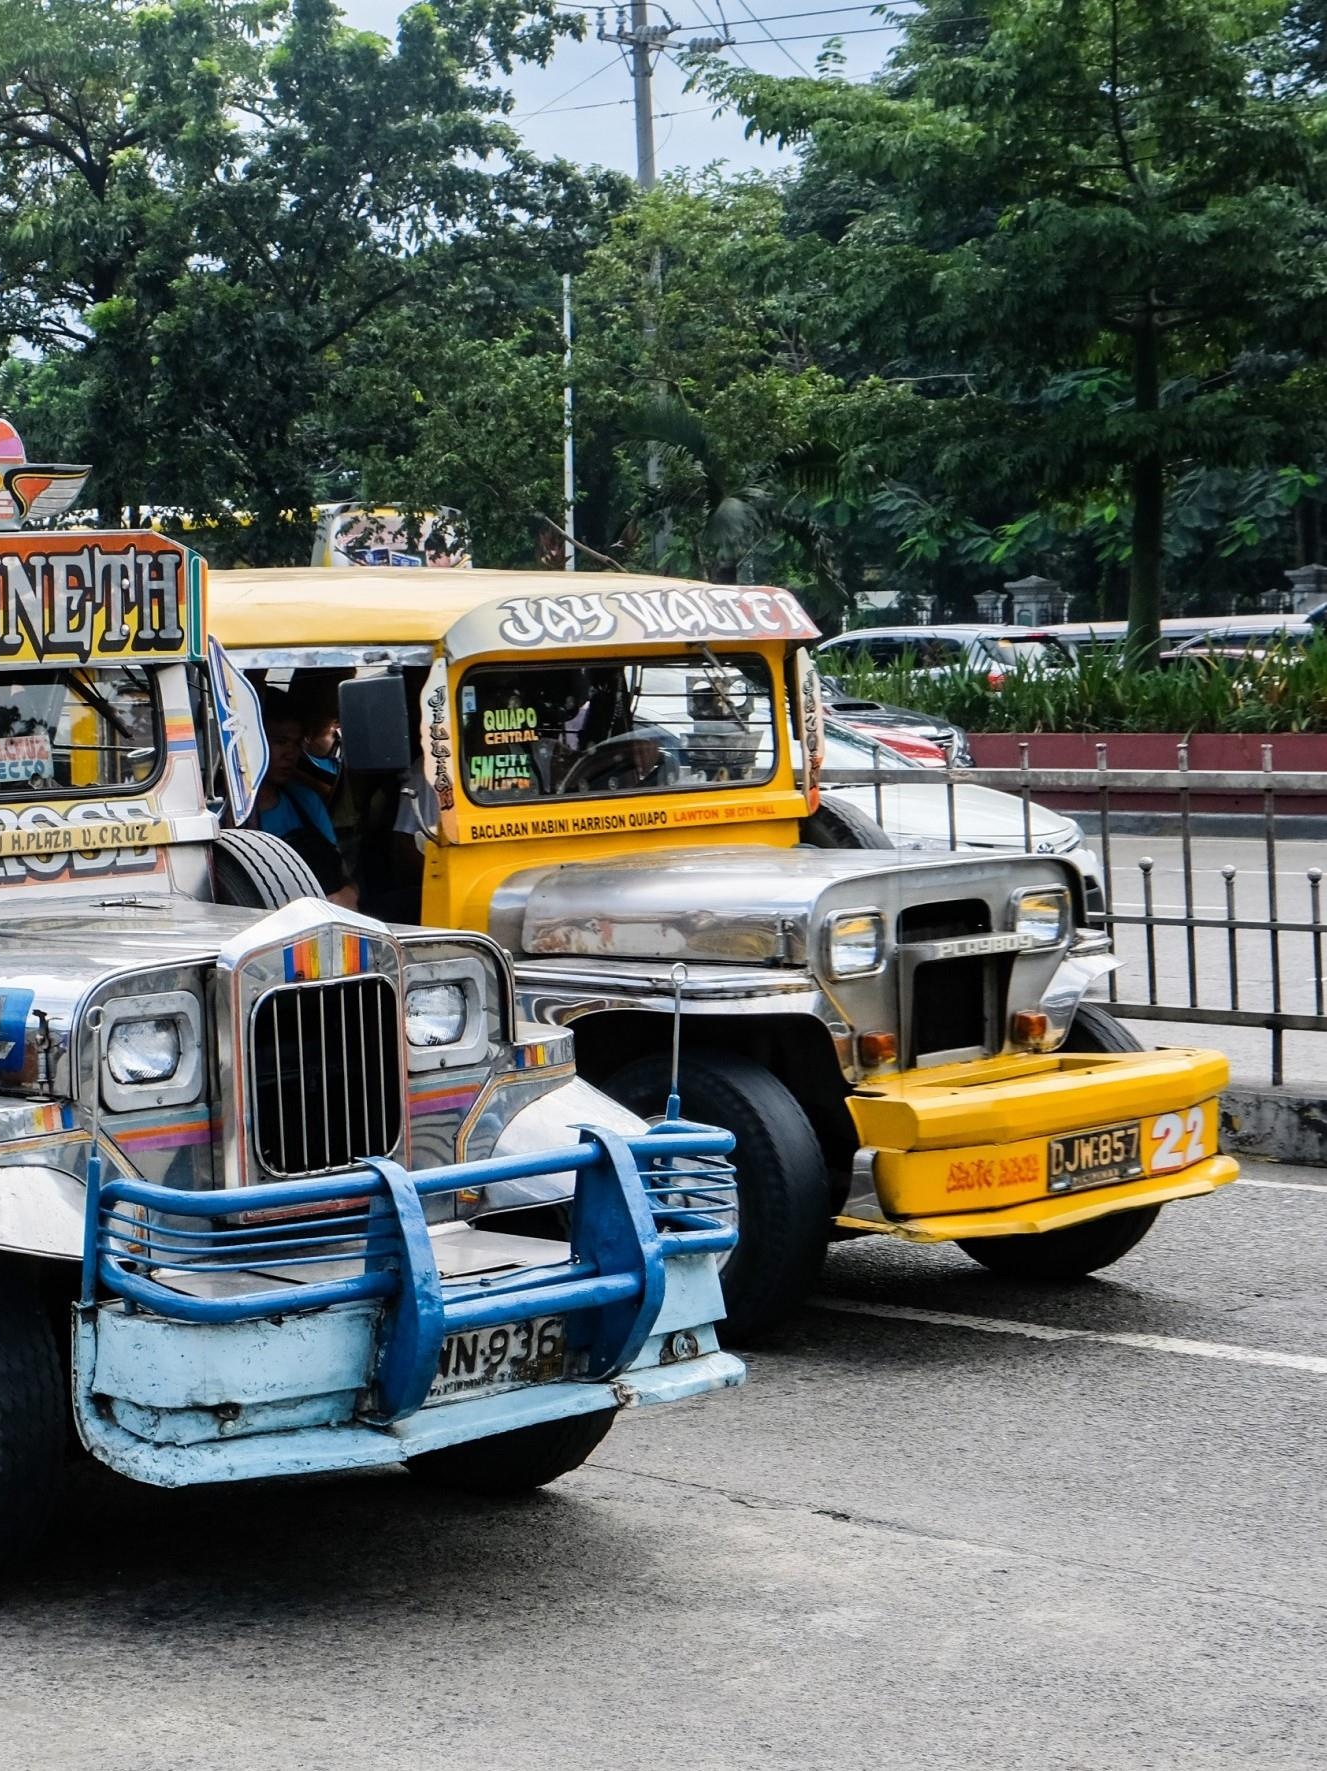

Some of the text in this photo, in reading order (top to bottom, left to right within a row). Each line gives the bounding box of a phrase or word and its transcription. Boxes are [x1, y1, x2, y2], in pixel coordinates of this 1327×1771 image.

[497, 587, 815, 647] JAY WALTER
[483, 707, 538, 731] QUIAPO
[484, 730, 539, 745] CENTRAL
[495, 754, 527, 767] CITY
[495, 766, 531, 779] HALL
[470, 822, 529, 840] BACLARAN
[531, 818, 570, 835] MABINI
[572, 814, 626, 832] HARRISON
[628, 811, 667, 827] QUIAPO
[673, 809, 719, 822] LAWTON
[737, 806, 754, 817] CITY
[756, 804, 776, 815] HALL
[11, 829, 72, 852] H.PLAZA
[99, 823, 149, 844] CRUZ
[938, 934, 1034, 959] PLAYBOY
[1151, 1105, 1205, 1174] 22
